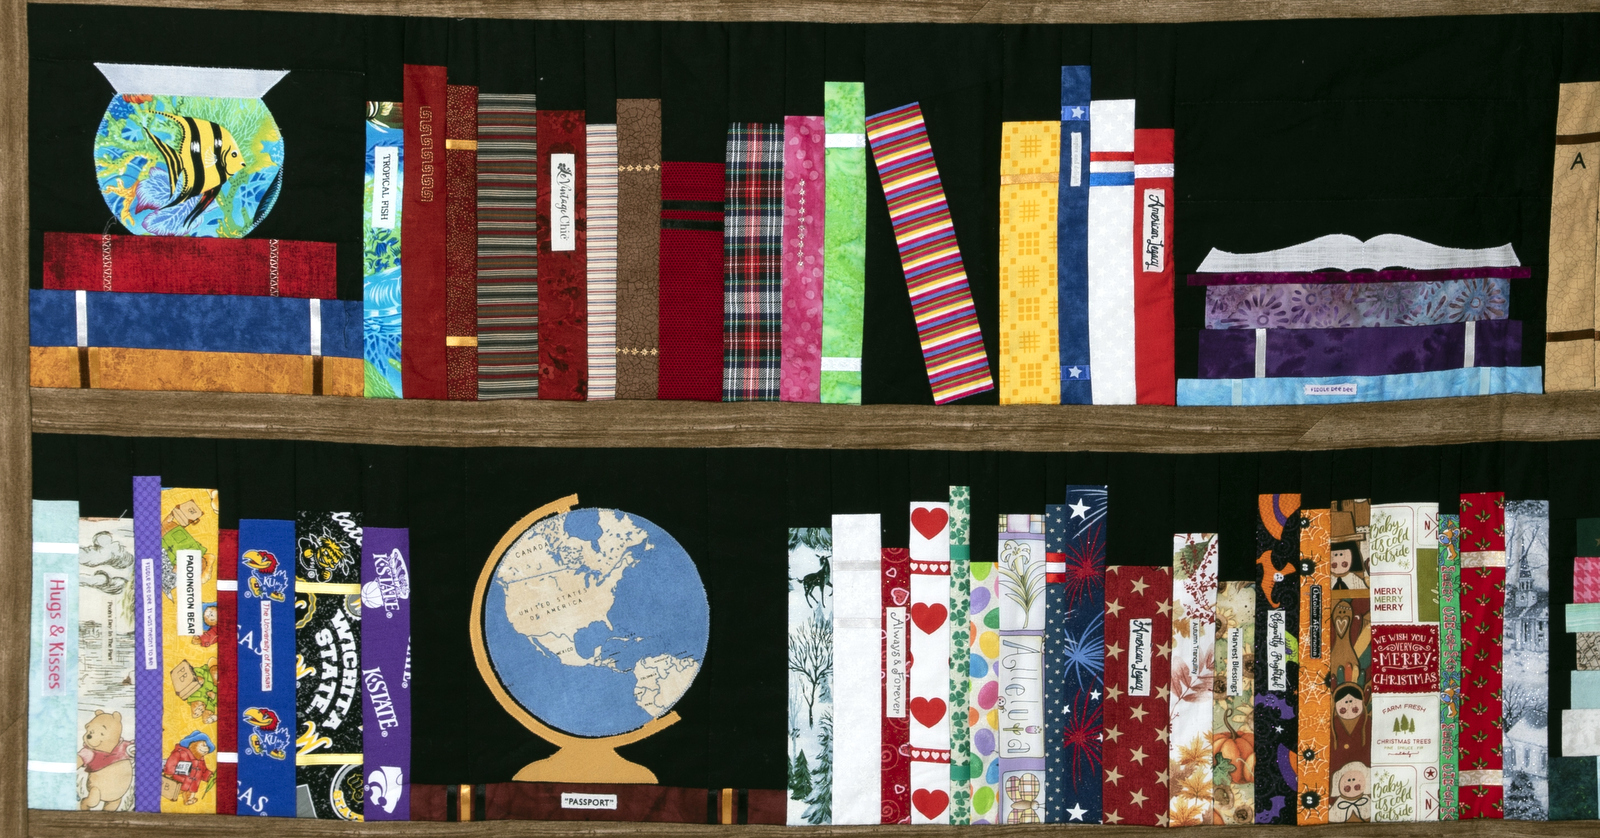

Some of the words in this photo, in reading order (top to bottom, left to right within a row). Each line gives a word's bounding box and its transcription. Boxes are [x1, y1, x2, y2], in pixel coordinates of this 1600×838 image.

[1570, 152, 1586, 170] A
[382, 154, 391, 199] TROPICAL
[381, 200, 389, 221] FISH
[555, 178, 572, 216] Vintage
[560, 215, 570, 240] Chic
[1148, 194, 1165, 239] American
[1145, 239, 1164, 270] Legacy
[1370, 515, 1406, 539] Baby
[1386, 527, 1409, 546] cold
[515, 541, 549, 559] CANADA
[1371, 545, 1410, 566] Outside
[186, 554, 195, 609] PADDINGTON
[1441, 565, 1456, 602] MERRY
[46, 579, 65, 620] Hugs
[262, 603, 270, 616] The
[519, 601, 551, 616] UNITED
[556, 587, 588, 602] STATES
[546, 598, 583, 615] AMERICA
[1312, 588, 1320, 617] October
[1374, 603, 1404, 611] MERRY
[49, 624, 65, 637] &
[186, 611, 196, 634] BEAR
[262, 619, 271, 653] University
[890, 612, 904, 657] Always
[1268, 611, 1285, 648] Elegantly
[556, 646, 574, 656] MEXICO
[1132, 619, 1150, 664] American
[1310, 618, 1320, 657] Afternoon
[1373, 635, 1387, 644] WE
[1388, 633, 1408, 641] WISH
[1411, 633, 1427, 642] YOU
[1428, 636, 1434, 644] A
[1395, 642, 1412, 651] VERY
[1442, 606, 1458, 672] CHRISTMAS
[48, 642, 64, 690] Kisses
[263, 653, 271, 662] of
[322, 608, 358, 730] WICHITA
[1191, 645, 1199, 675] Tranquility
[1268, 651, 1285, 689] Frightful
[1379, 652, 1432, 666] MERRY
[177, 665, 189, 683] PB
[315, 628, 338, 715] STATE
[1129, 663, 1148, 694] Legacy
[1373, 672, 1437, 685] CHRISTMAS
[891, 668, 904, 714] Forever
[1382, 704, 1402, 715] FARM
[1403, 703, 1426, 713] FRESH
[1441, 723, 1455, 760] MERRY
[1372, 774, 1410, 799] Baby
[1389, 786, 1413, 806] cold
[564, 797, 614, 807] "PASSPORT"
